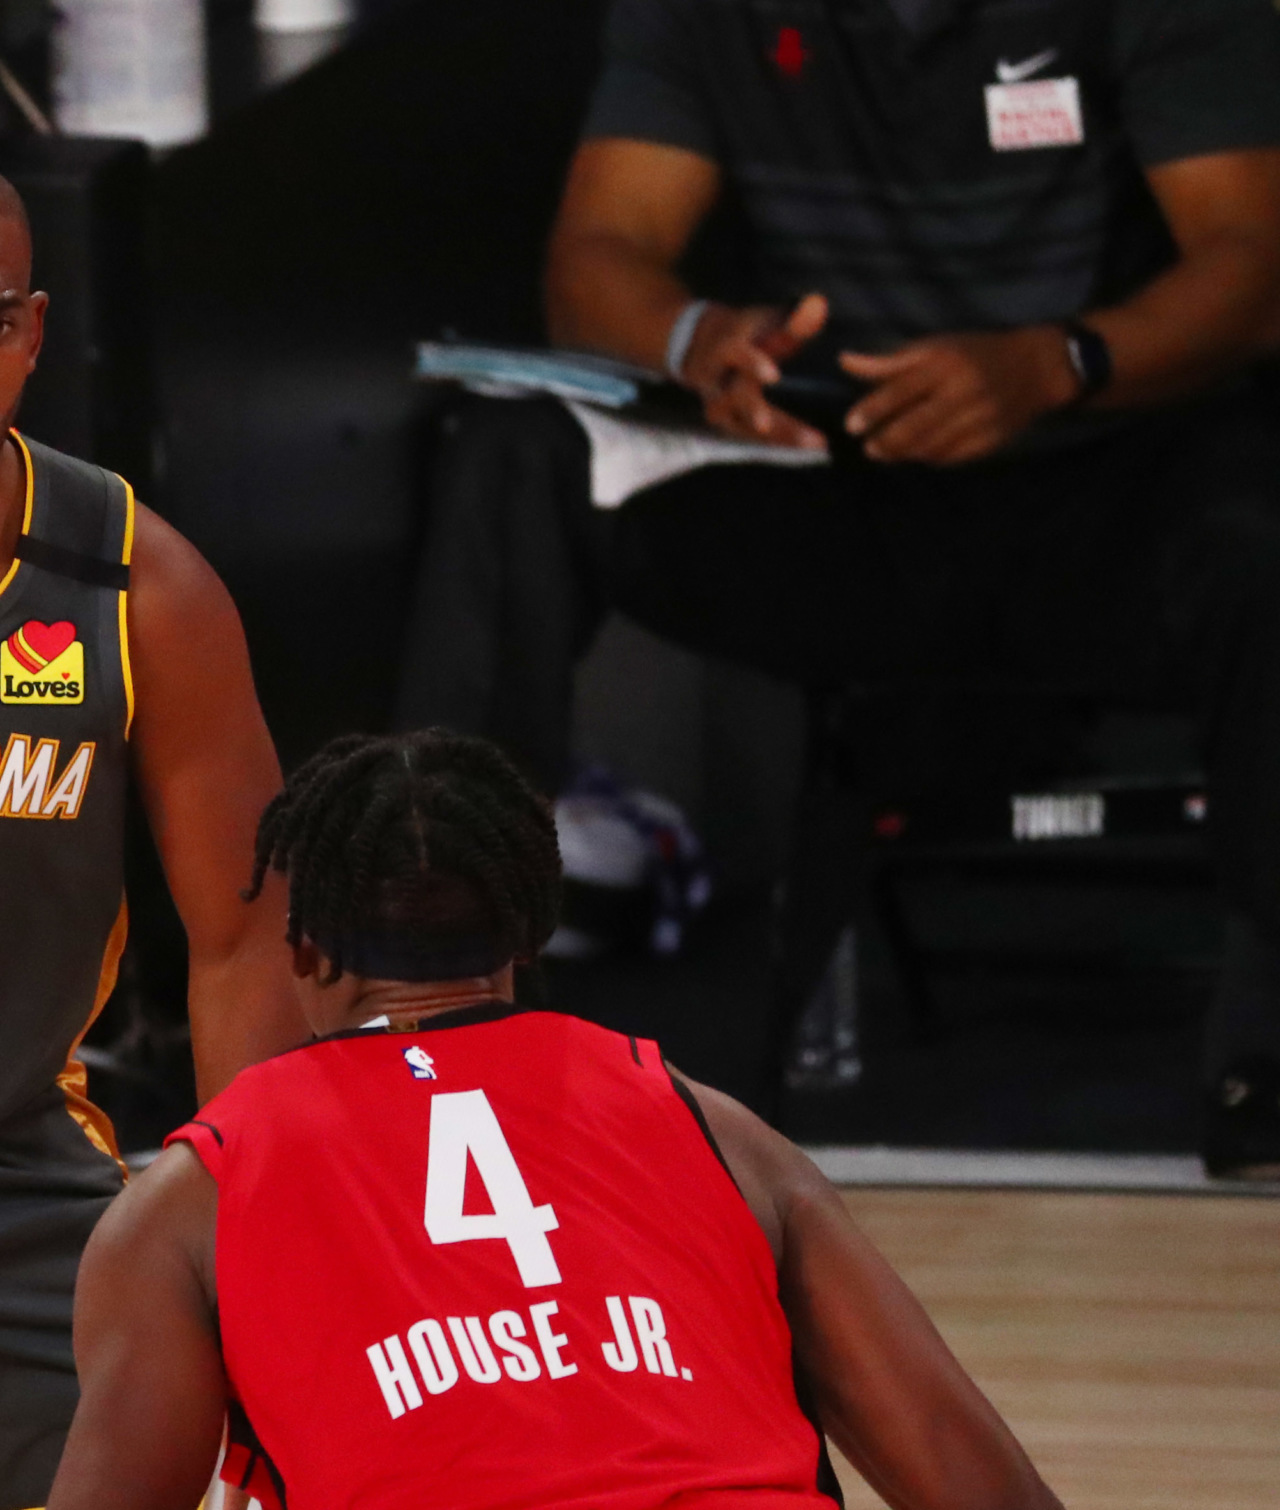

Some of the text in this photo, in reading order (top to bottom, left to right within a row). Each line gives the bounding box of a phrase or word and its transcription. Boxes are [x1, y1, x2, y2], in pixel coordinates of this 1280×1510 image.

[424, 1089, 563, 1288] 4
[366, 1296, 693, 1420] HOUSE JR.
